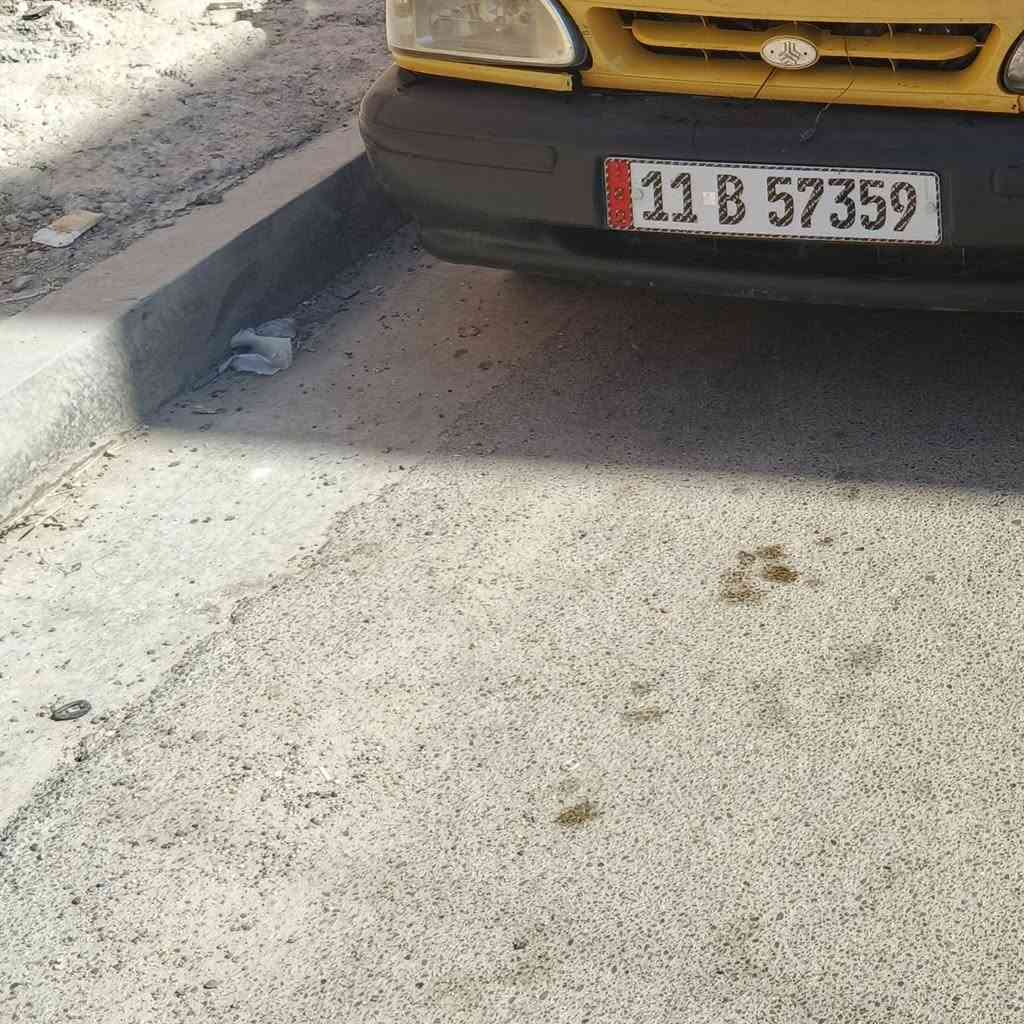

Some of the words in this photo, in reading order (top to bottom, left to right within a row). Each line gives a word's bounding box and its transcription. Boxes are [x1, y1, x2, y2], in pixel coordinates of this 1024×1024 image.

[640, 170, 698, 224] 11
[716, 173, 746, 225] B
[766, 175, 917, 232] 57359
